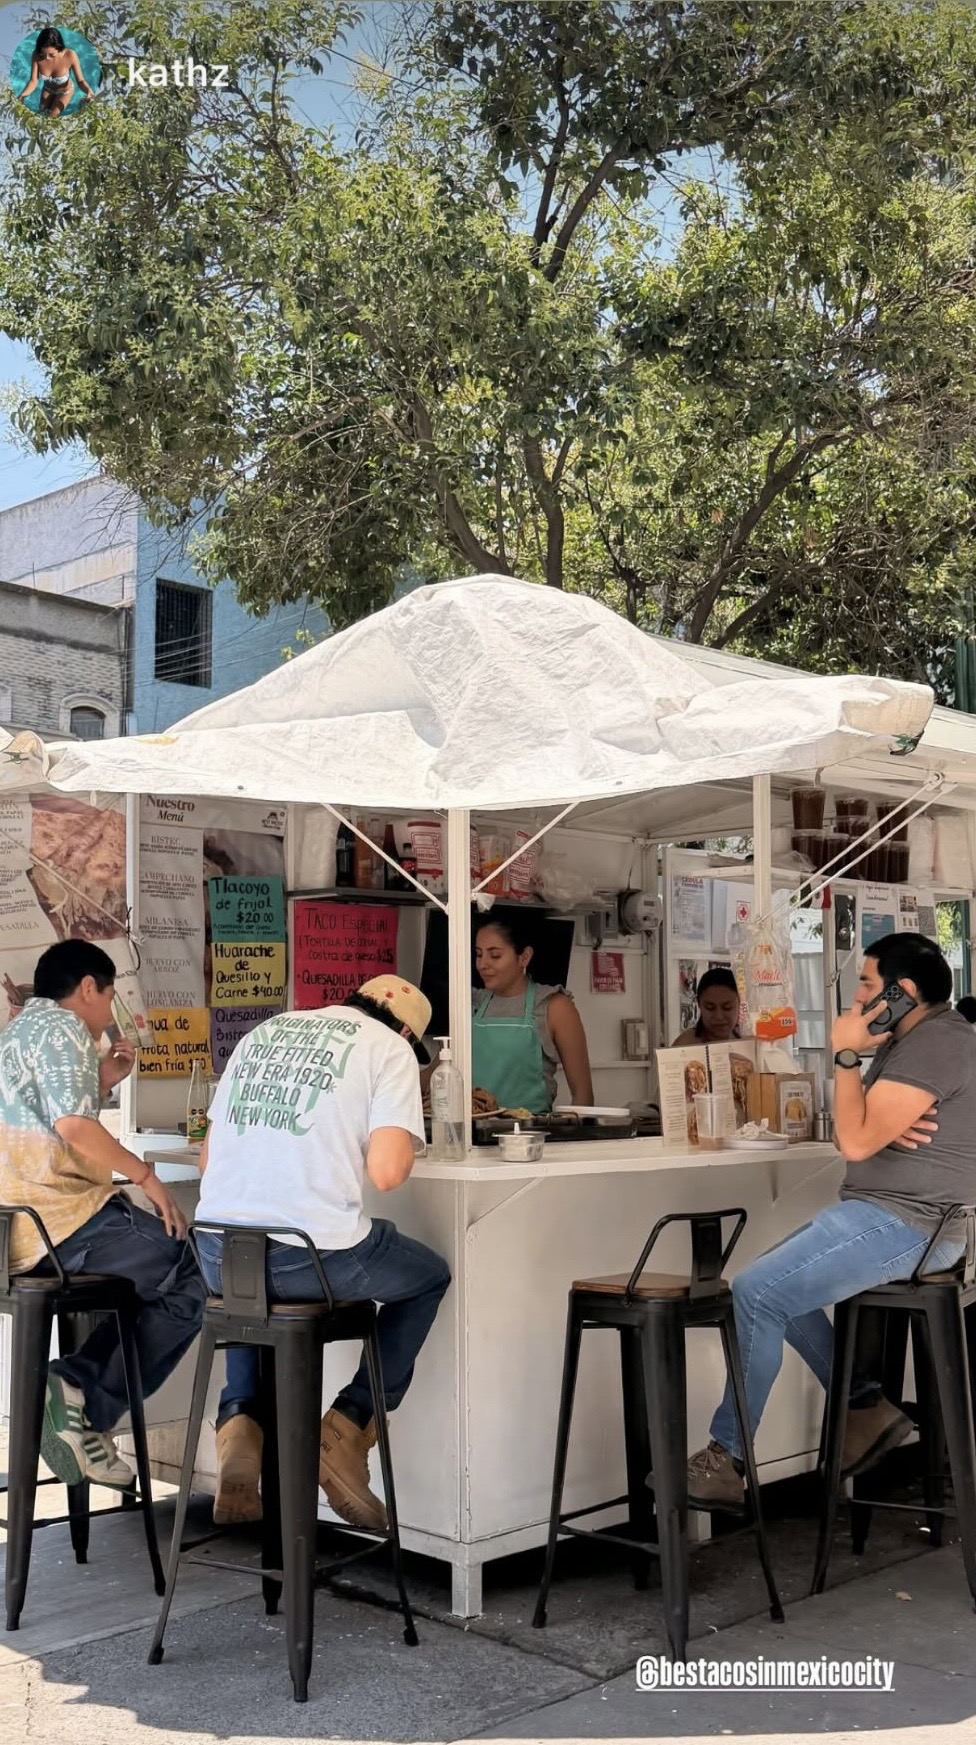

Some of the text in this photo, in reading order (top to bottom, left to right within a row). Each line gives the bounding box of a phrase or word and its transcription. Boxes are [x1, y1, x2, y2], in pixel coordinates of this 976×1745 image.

[146, 794, 195, 812] Nuestro
[157, 809, 185, 822] Menú
[210, 876, 270, 897] Tlacoyo
[216, 899, 231, 910] de
[214, 943, 276, 958] Huarache
[234, 960, 250, 971] de
[216, 971, 261, 984] Quesillo
[215, 987, 248, 999] Carne
[175, 1015, 190, 1031] de
[215, 1008, 274, 1023] Quesadilla
[271, 1029, 323, 1045] OF THE
[174, 1038, 210, 1056] natural
[245, 1043, 283, 1060] TRUE
[281, 1047, 334, 1067] FITTED
[231, 1062, 262, 1080] NEW
[262, 1063, 291, 1082] ERA
[240, 1083, 301, 1107] BUFFALO
[228, 1105, 302, 1131] NEW YORK
